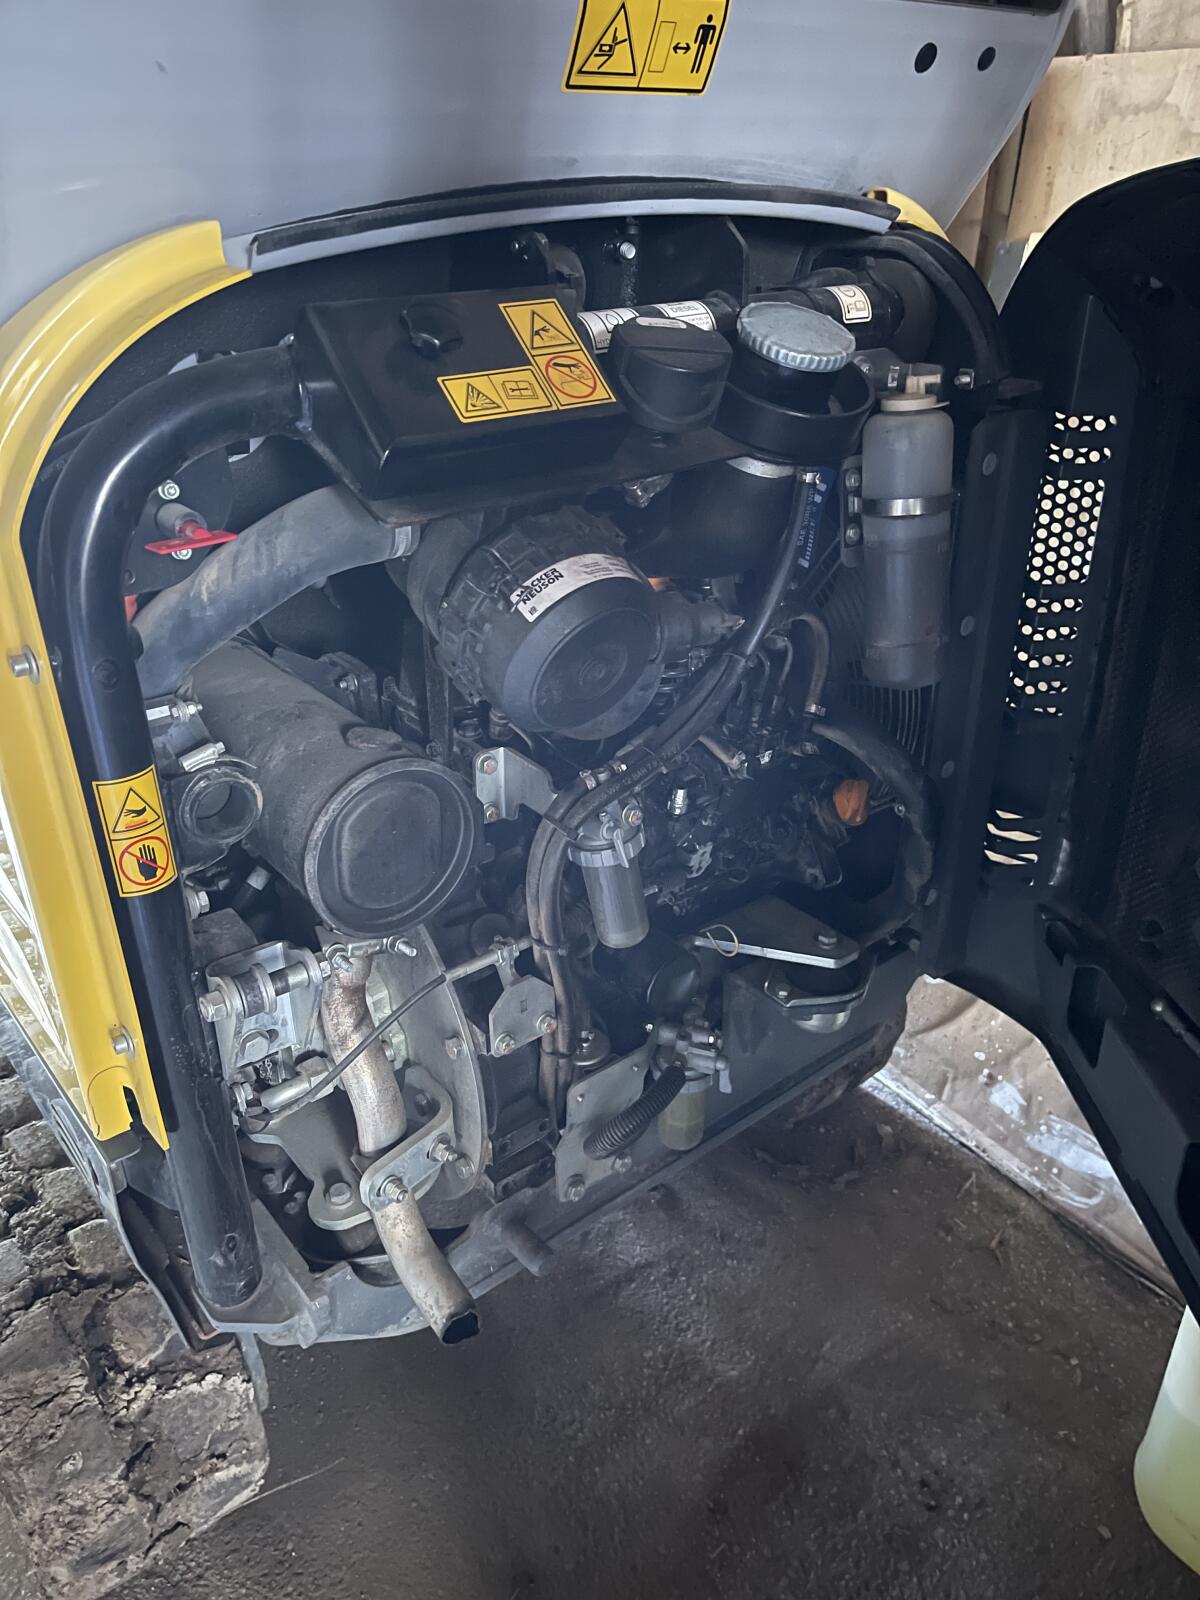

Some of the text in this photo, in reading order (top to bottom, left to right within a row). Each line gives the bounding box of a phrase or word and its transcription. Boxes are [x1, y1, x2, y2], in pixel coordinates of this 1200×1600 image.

[669, 305, 699, 313] DIESEL
[516, 567, 560, 598] WCKER
[521, 572, 565, 605] NEUSON
